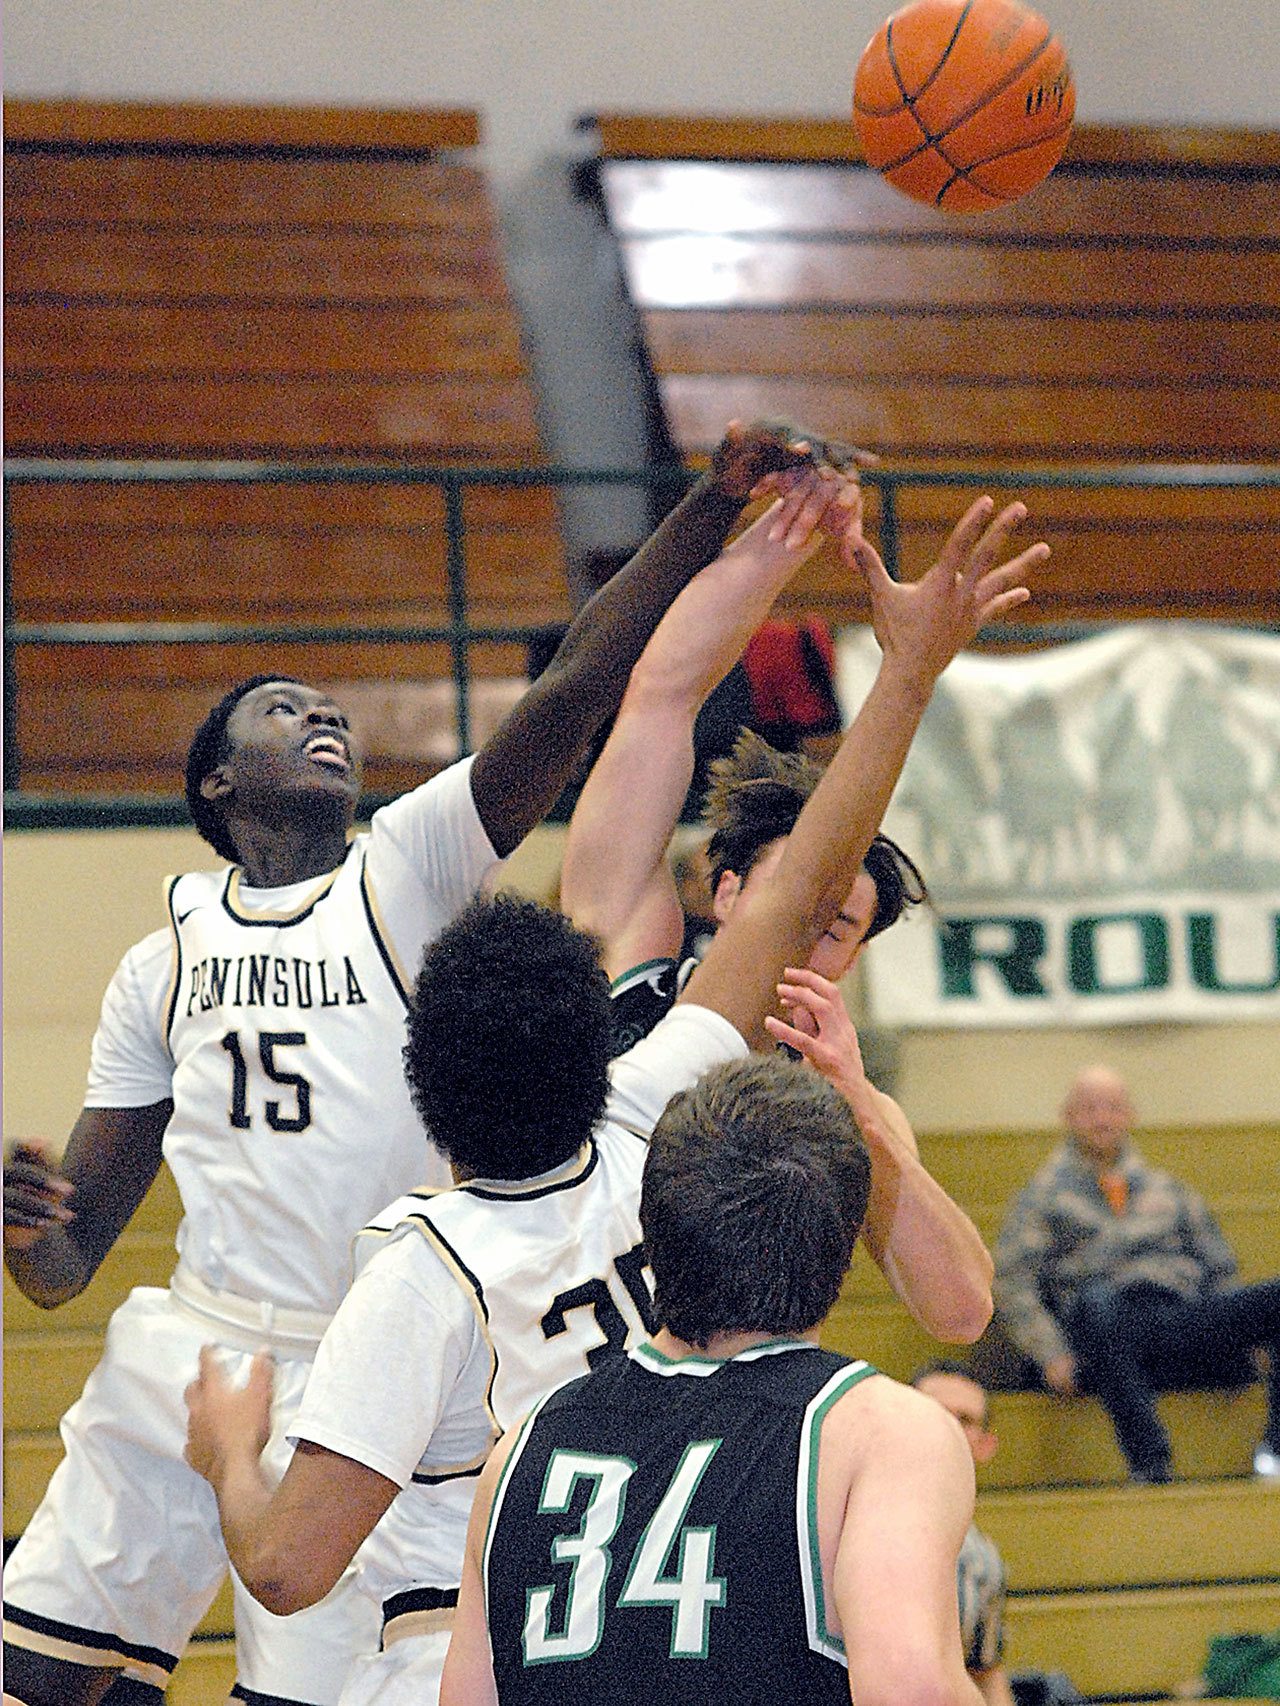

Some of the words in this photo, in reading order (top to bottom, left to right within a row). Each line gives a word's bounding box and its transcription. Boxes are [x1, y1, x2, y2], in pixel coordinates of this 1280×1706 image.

[186, 954, 367, 1017] PENINSULA
[221, 1031, 311, 1133] 15
[522, 1438, 727, 1668] 34
